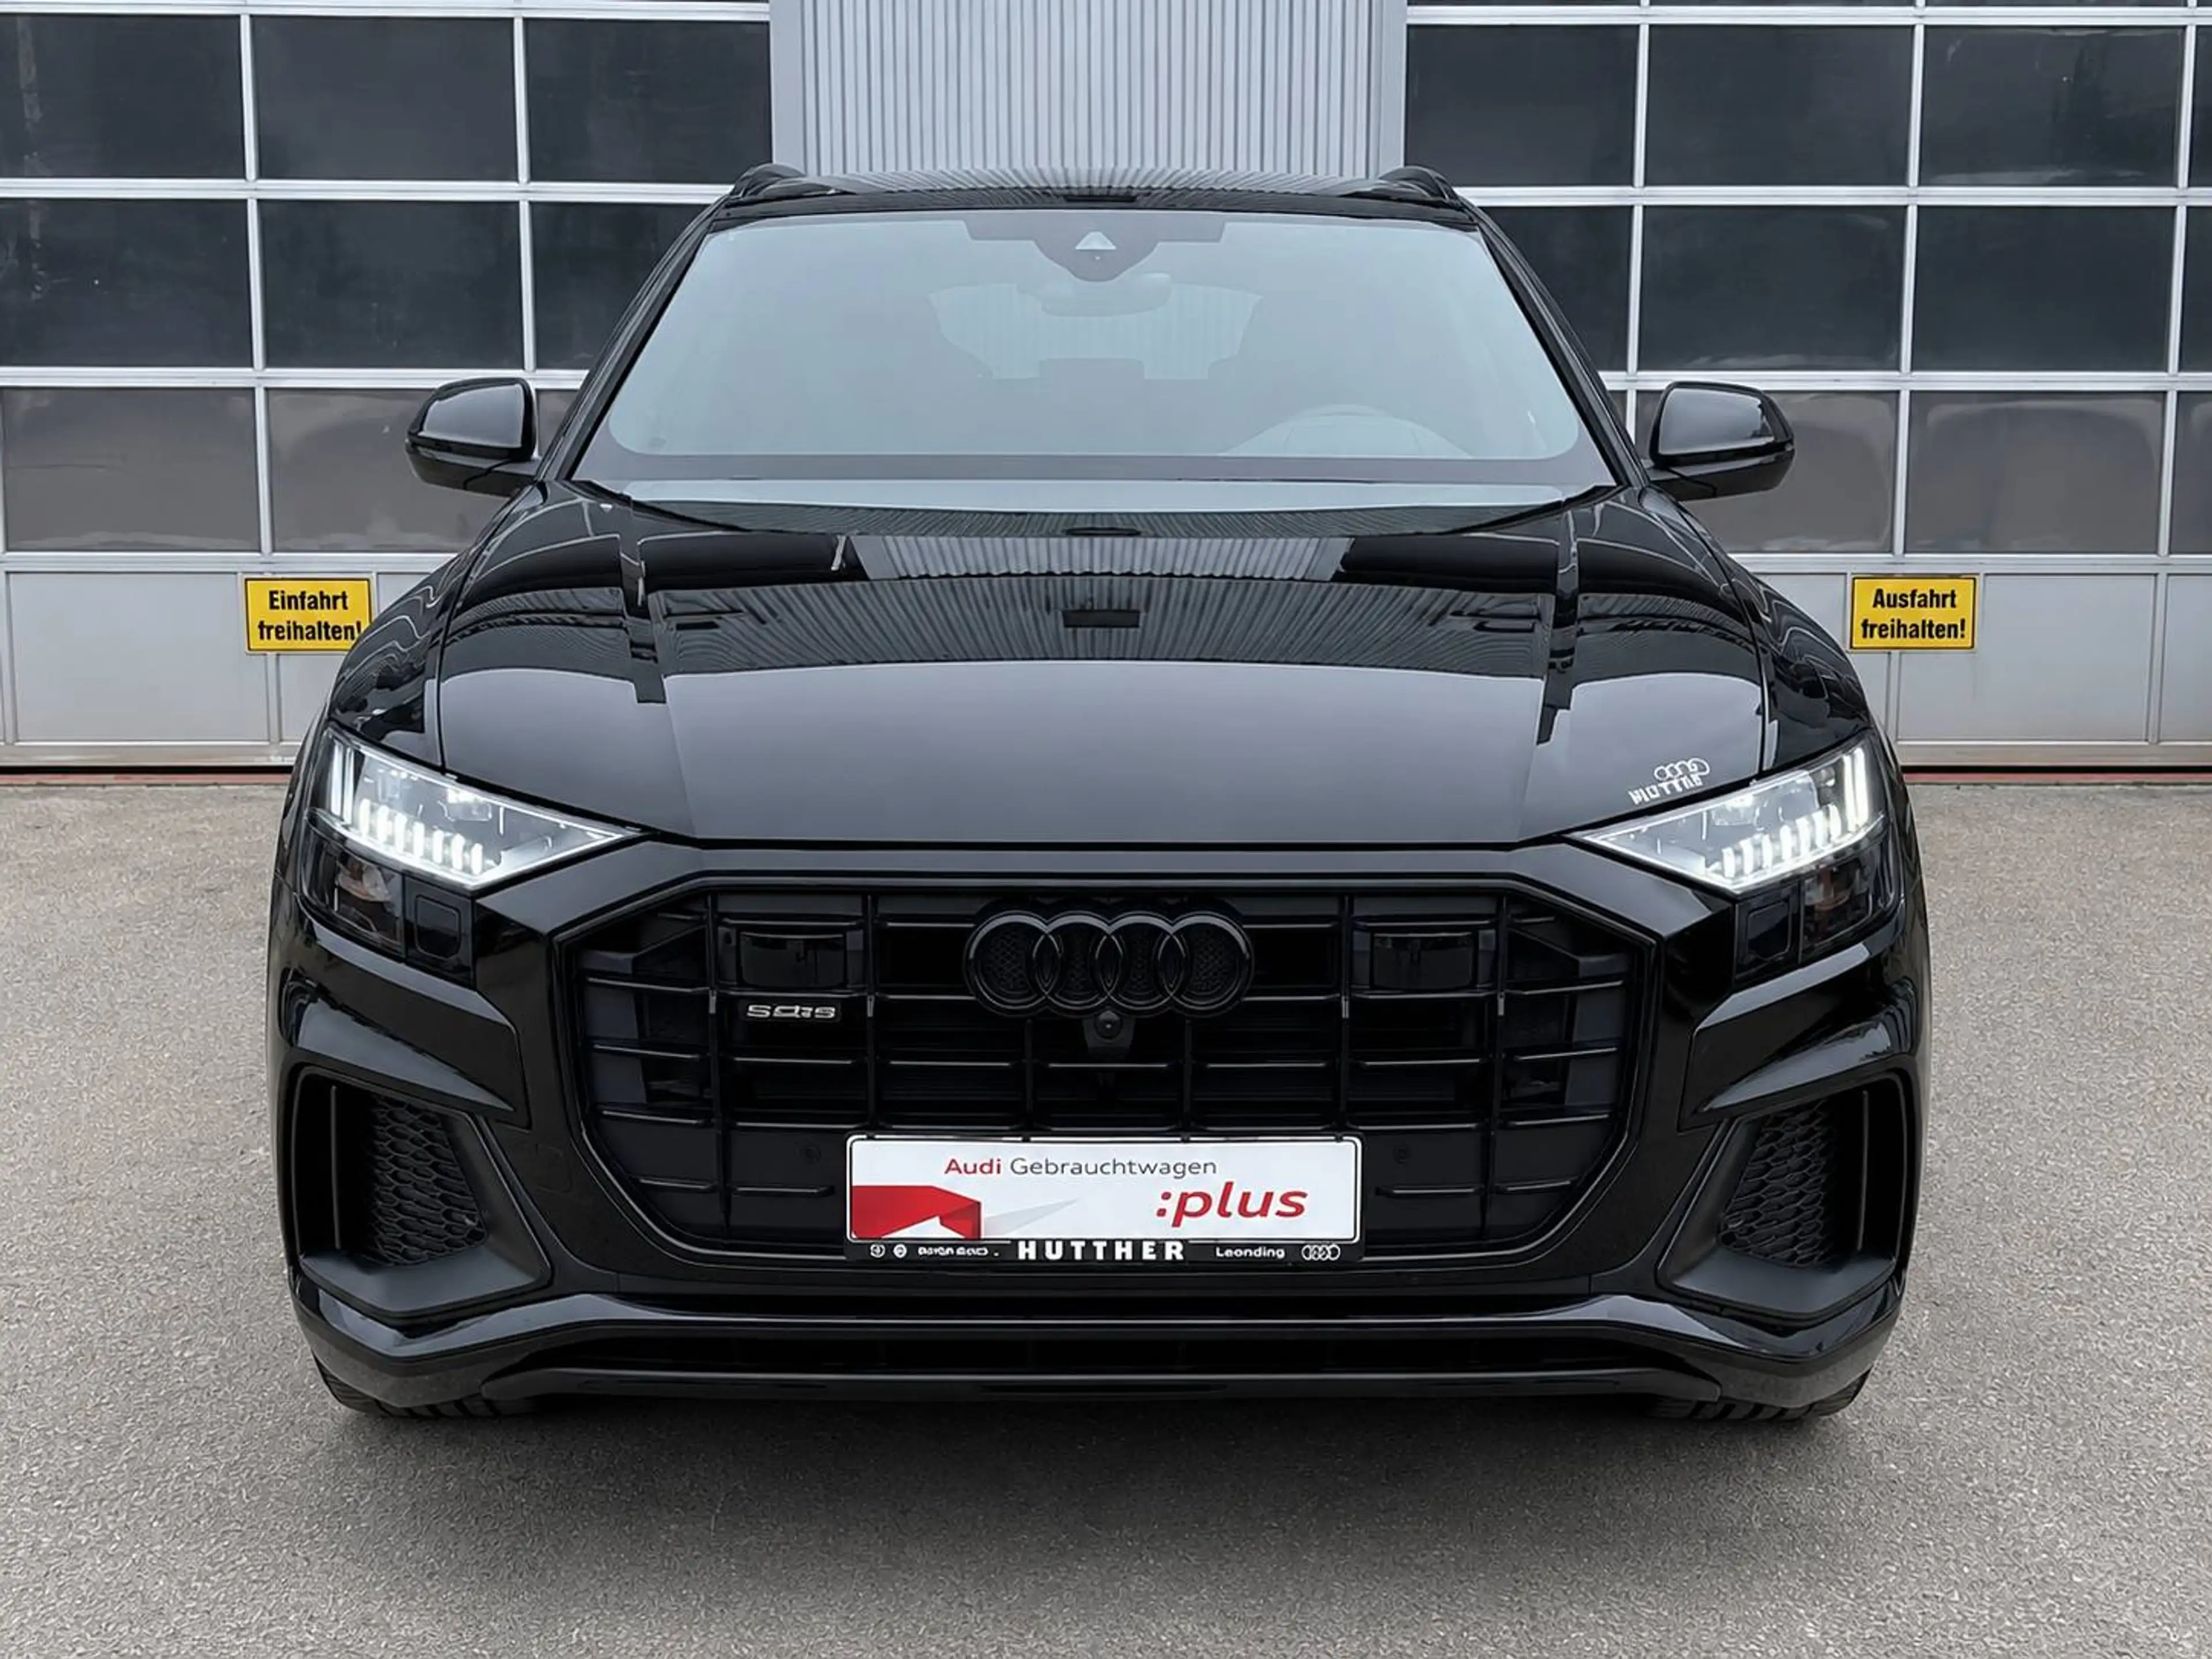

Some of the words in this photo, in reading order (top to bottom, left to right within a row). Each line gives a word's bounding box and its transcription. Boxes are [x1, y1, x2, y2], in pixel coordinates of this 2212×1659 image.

[268, 590, 349, 610] Einfahrt
[1872, 588, 1957, 608] Ausfahrt
[1861, 618, 1965, 639] freihalten!
[944, 1158, 1002, 1175] Audi
[1010, 1158, 1217, 1179] Gebrauchtwagen
[1156, 1181, 1308, 1228] :plus
[1017, 1240, 1185, 1260] HUTTHER
